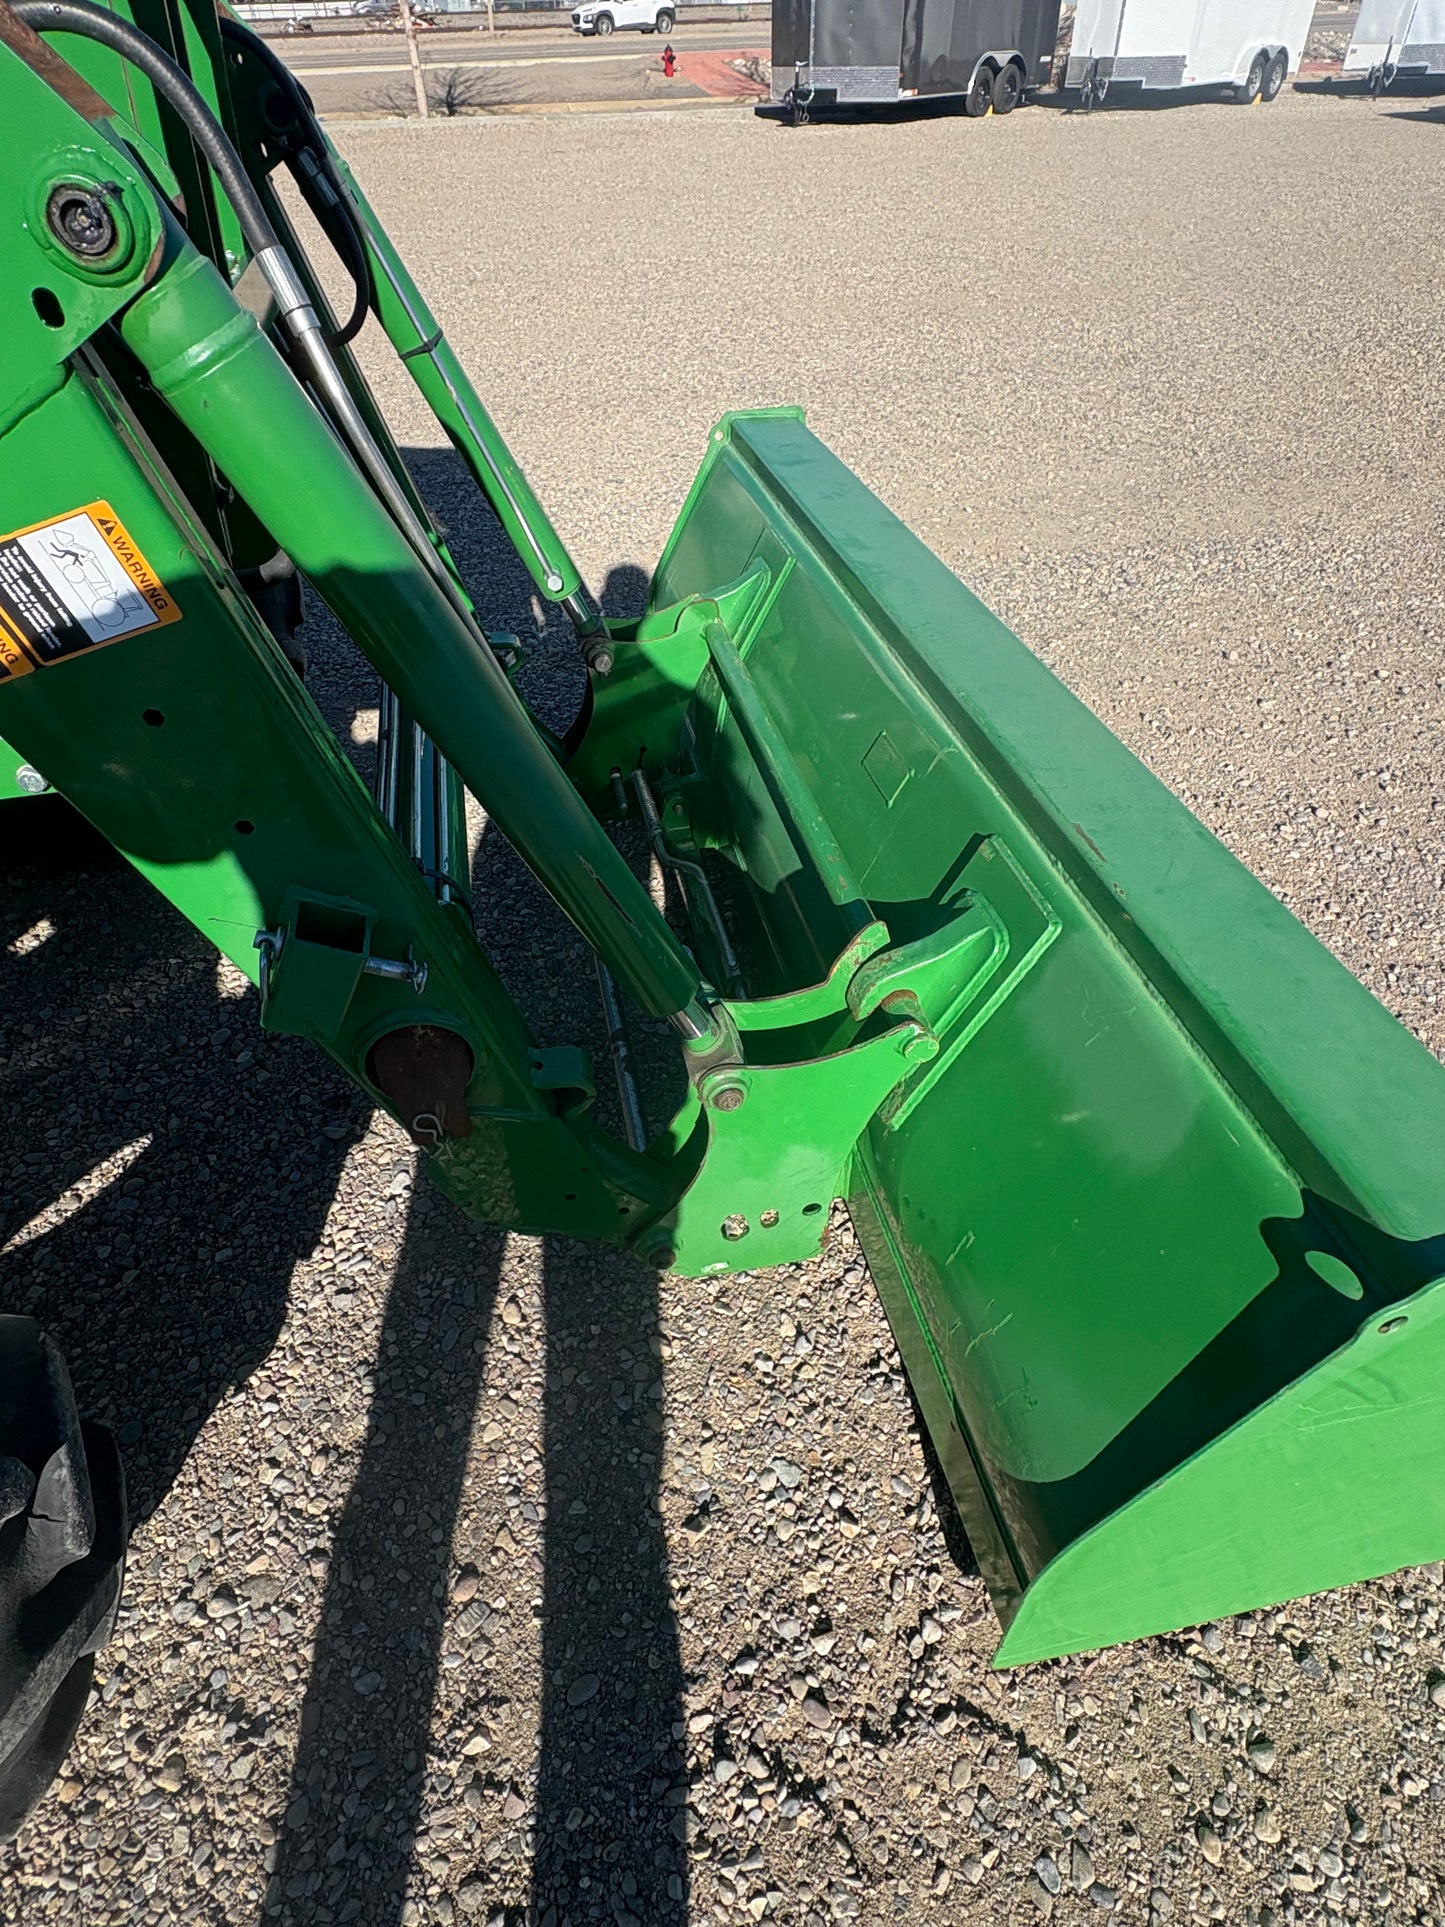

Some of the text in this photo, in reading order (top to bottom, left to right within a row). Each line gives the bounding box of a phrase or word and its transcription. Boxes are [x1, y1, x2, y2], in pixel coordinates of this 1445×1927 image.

[8, 567, 20, 580] not
[17, 579, 31, 595] walk
[113, 536, 168, 610] WARNING
[17, 555, 35, 574] avoid
[31, 573, 48, 592] injury
[45, 592, 59, 608] from
[56, 607, 73, 627] falling
[22, 611, 44, 633] ground
[30, 607, 49, 627] raised
